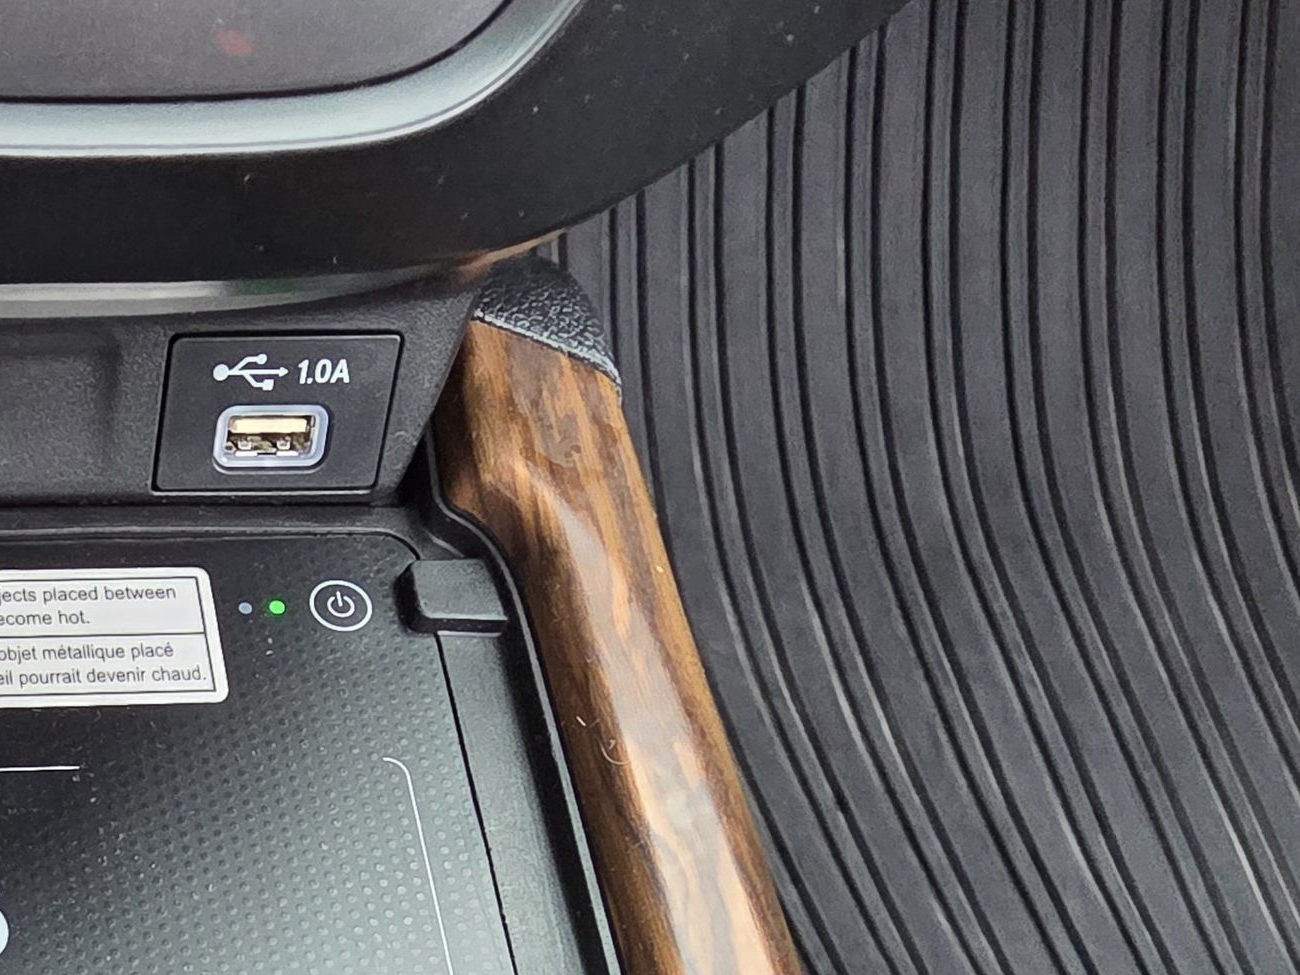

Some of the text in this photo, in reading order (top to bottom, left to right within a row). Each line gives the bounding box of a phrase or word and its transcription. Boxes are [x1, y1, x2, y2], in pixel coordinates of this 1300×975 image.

[297, 358, 351, 385] 1.0A
[42, 586, 99, 606] placed
[104, 585, 177, 601] between
[58, 610, 91, 625] hot.
[42, 644, 126, 666] métallique
[130, 641, 174, 662] placé
[18, 668, 82, 689] pourrait
[86, 666, 146, 684] devenir
[151, 665, 208, 682] chaud.
